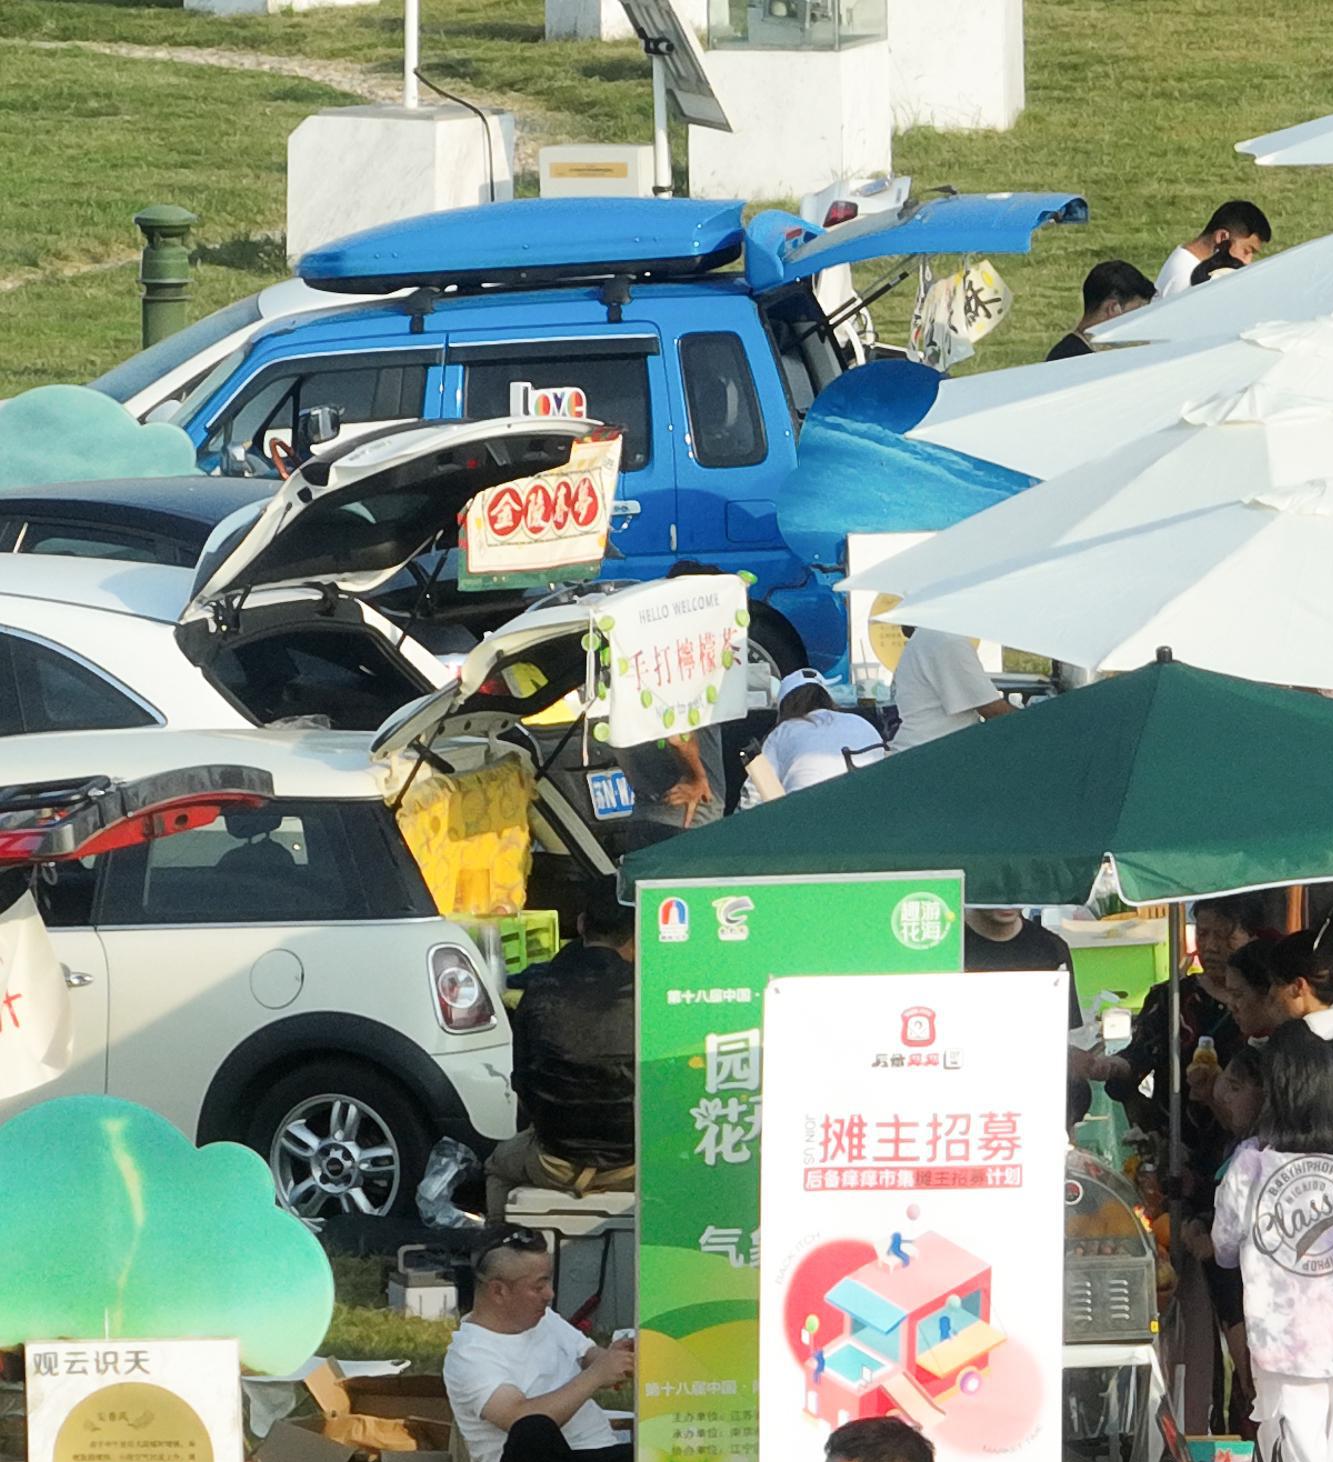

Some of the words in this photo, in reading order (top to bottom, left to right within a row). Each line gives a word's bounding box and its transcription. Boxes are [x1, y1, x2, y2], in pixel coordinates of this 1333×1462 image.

[639, 604, 670, 624] HELLO
[672, 593, 720, 615] WELCOME
[818, 1111, 1023, 1164] 摊主招募
[33, 1350, 151, 1377] 观云识天
